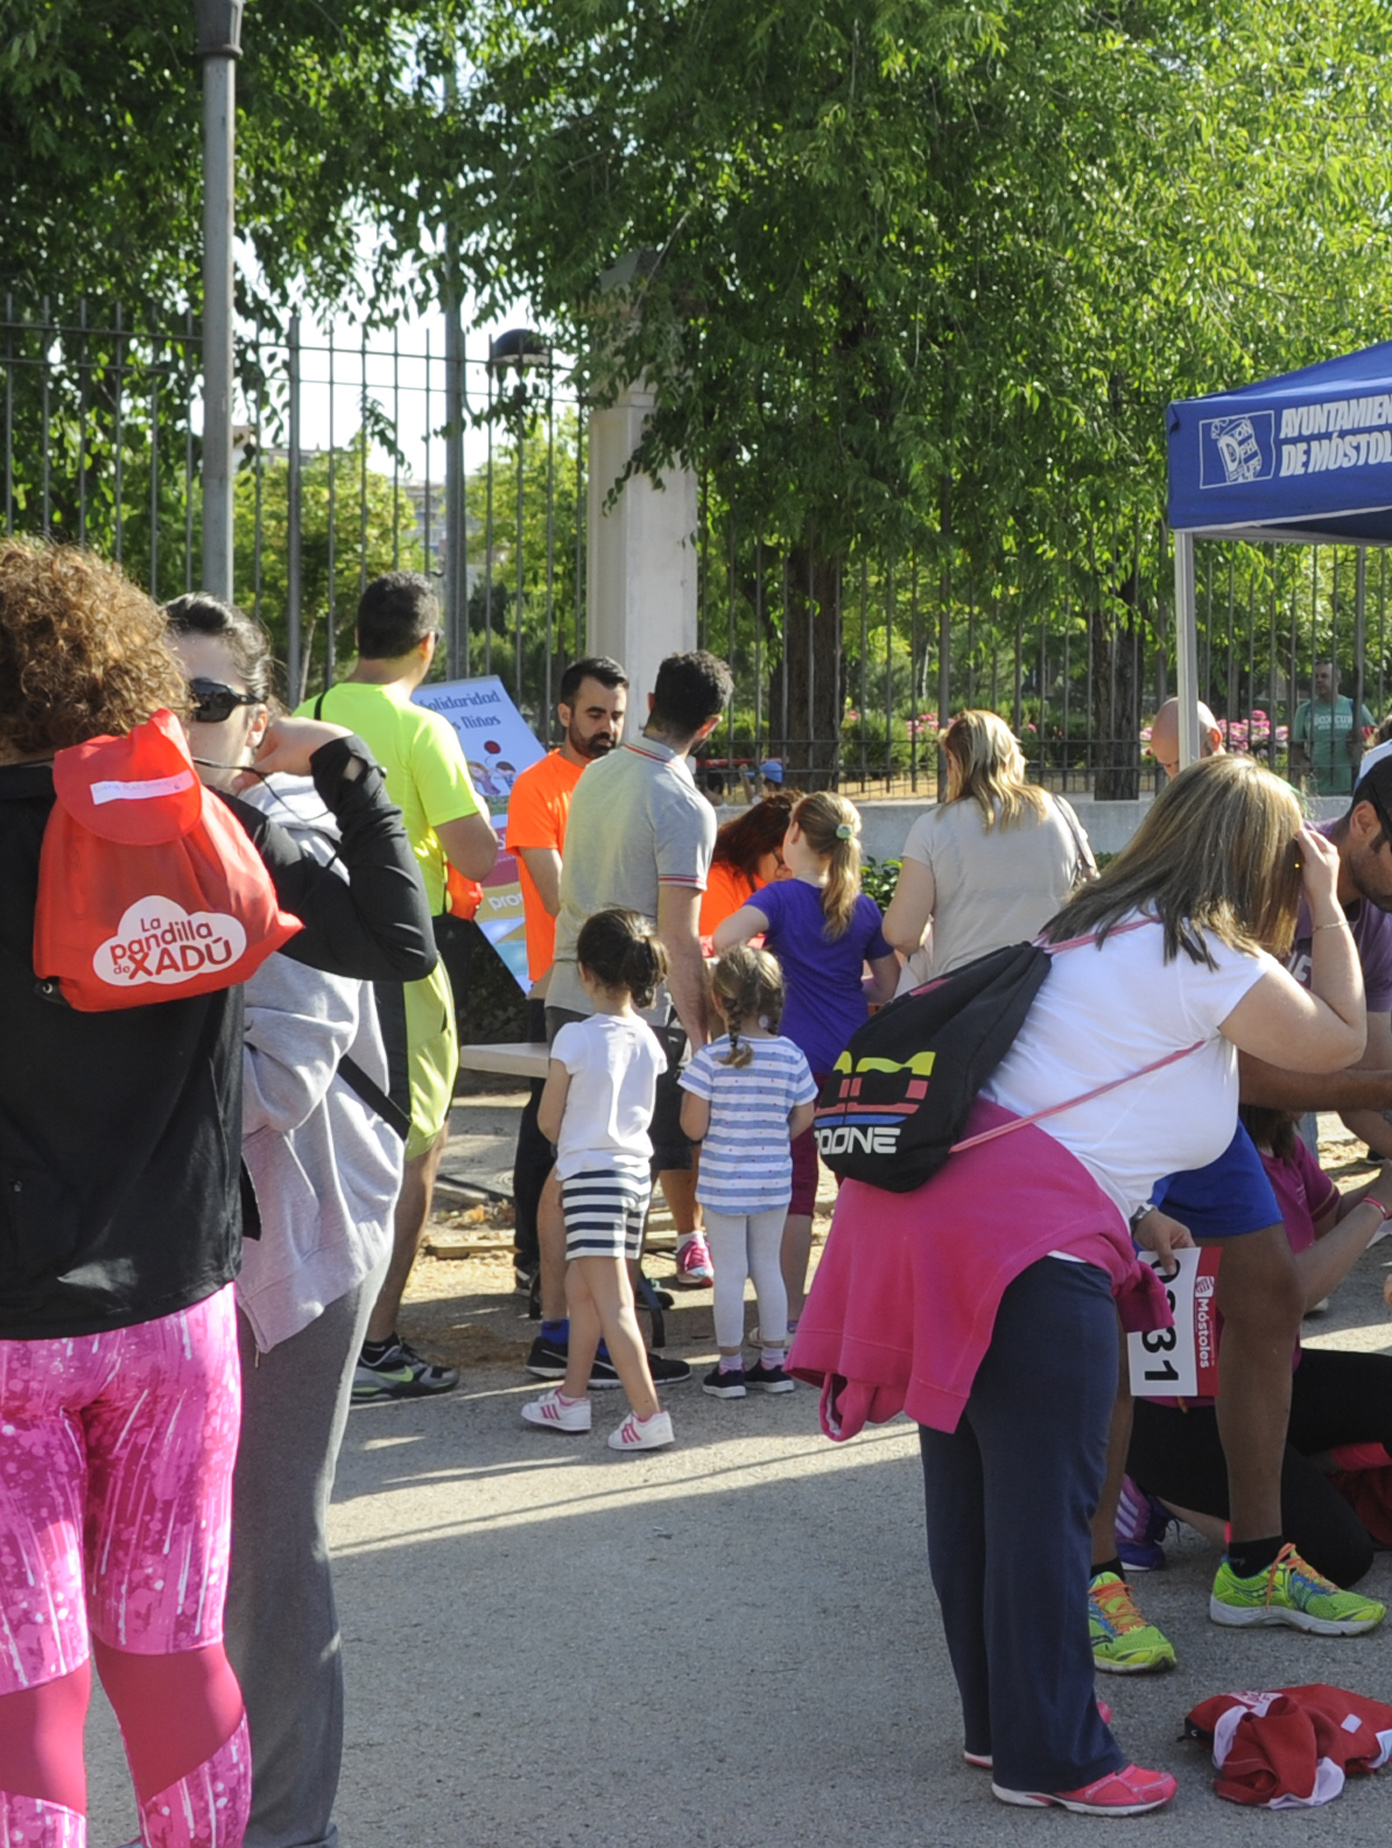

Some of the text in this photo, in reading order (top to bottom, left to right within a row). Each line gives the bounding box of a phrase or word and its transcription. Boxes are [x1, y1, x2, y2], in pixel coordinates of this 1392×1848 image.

[1279, 444, 1310, 477] DE
[110, 919, 213, 966] pandilla
[140, 917, 162, 933] La
[113, 936, 233, 980] de XADÚ
[1197, 1298, 1211, 1369] Móstoles
